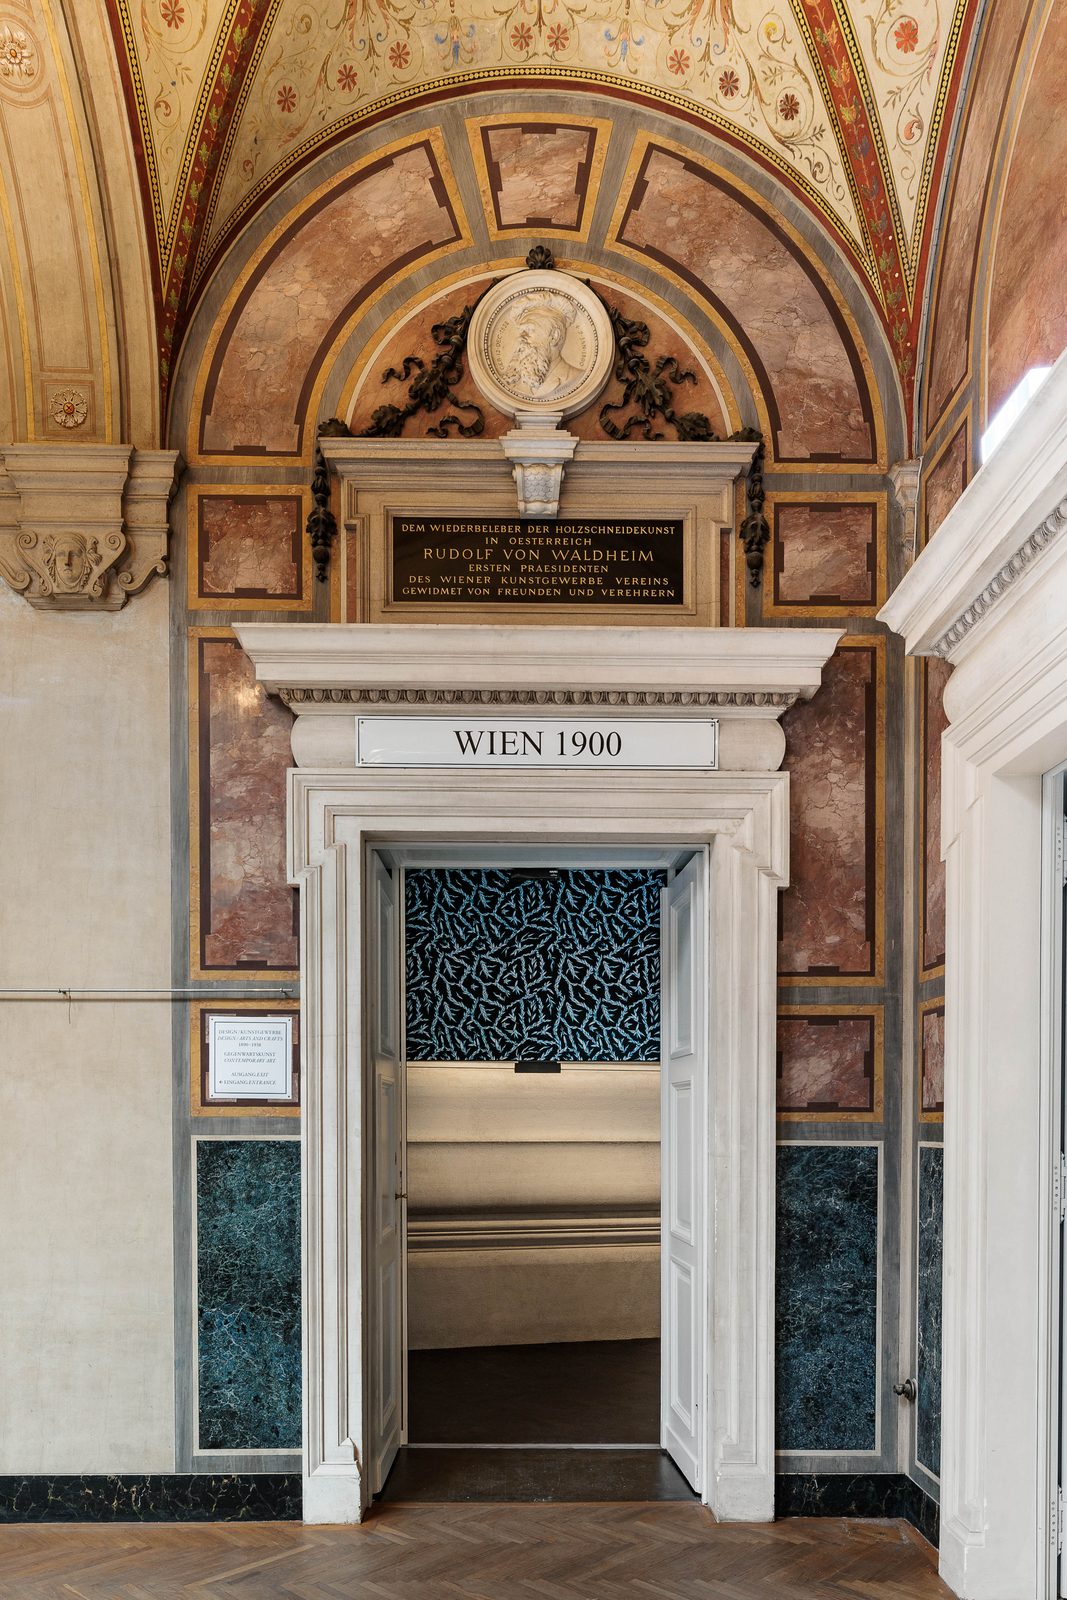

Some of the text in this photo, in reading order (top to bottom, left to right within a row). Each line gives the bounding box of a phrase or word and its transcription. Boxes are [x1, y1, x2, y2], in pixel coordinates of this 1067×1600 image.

[401, 523, 676, 535] DEM WIEDERBELEBER DER HOLZSCHNEIDEKUNST
[485, 537, 592, 546] IN OESTERREICH
[423, 548, 655, 562] RUDOLF VON WALDHEIM
[468, 564, 609, 573] ERSTEN PRAESIDENTEN
[409, 575, 669, 586] DES WIENER KUNSTGEWERBE VEREINS
[402, 587, 675, 597] GEWIDMET VON FREUNDEN UND VEREHRERN
[453, 730, 622, 757] WIEN 1900
